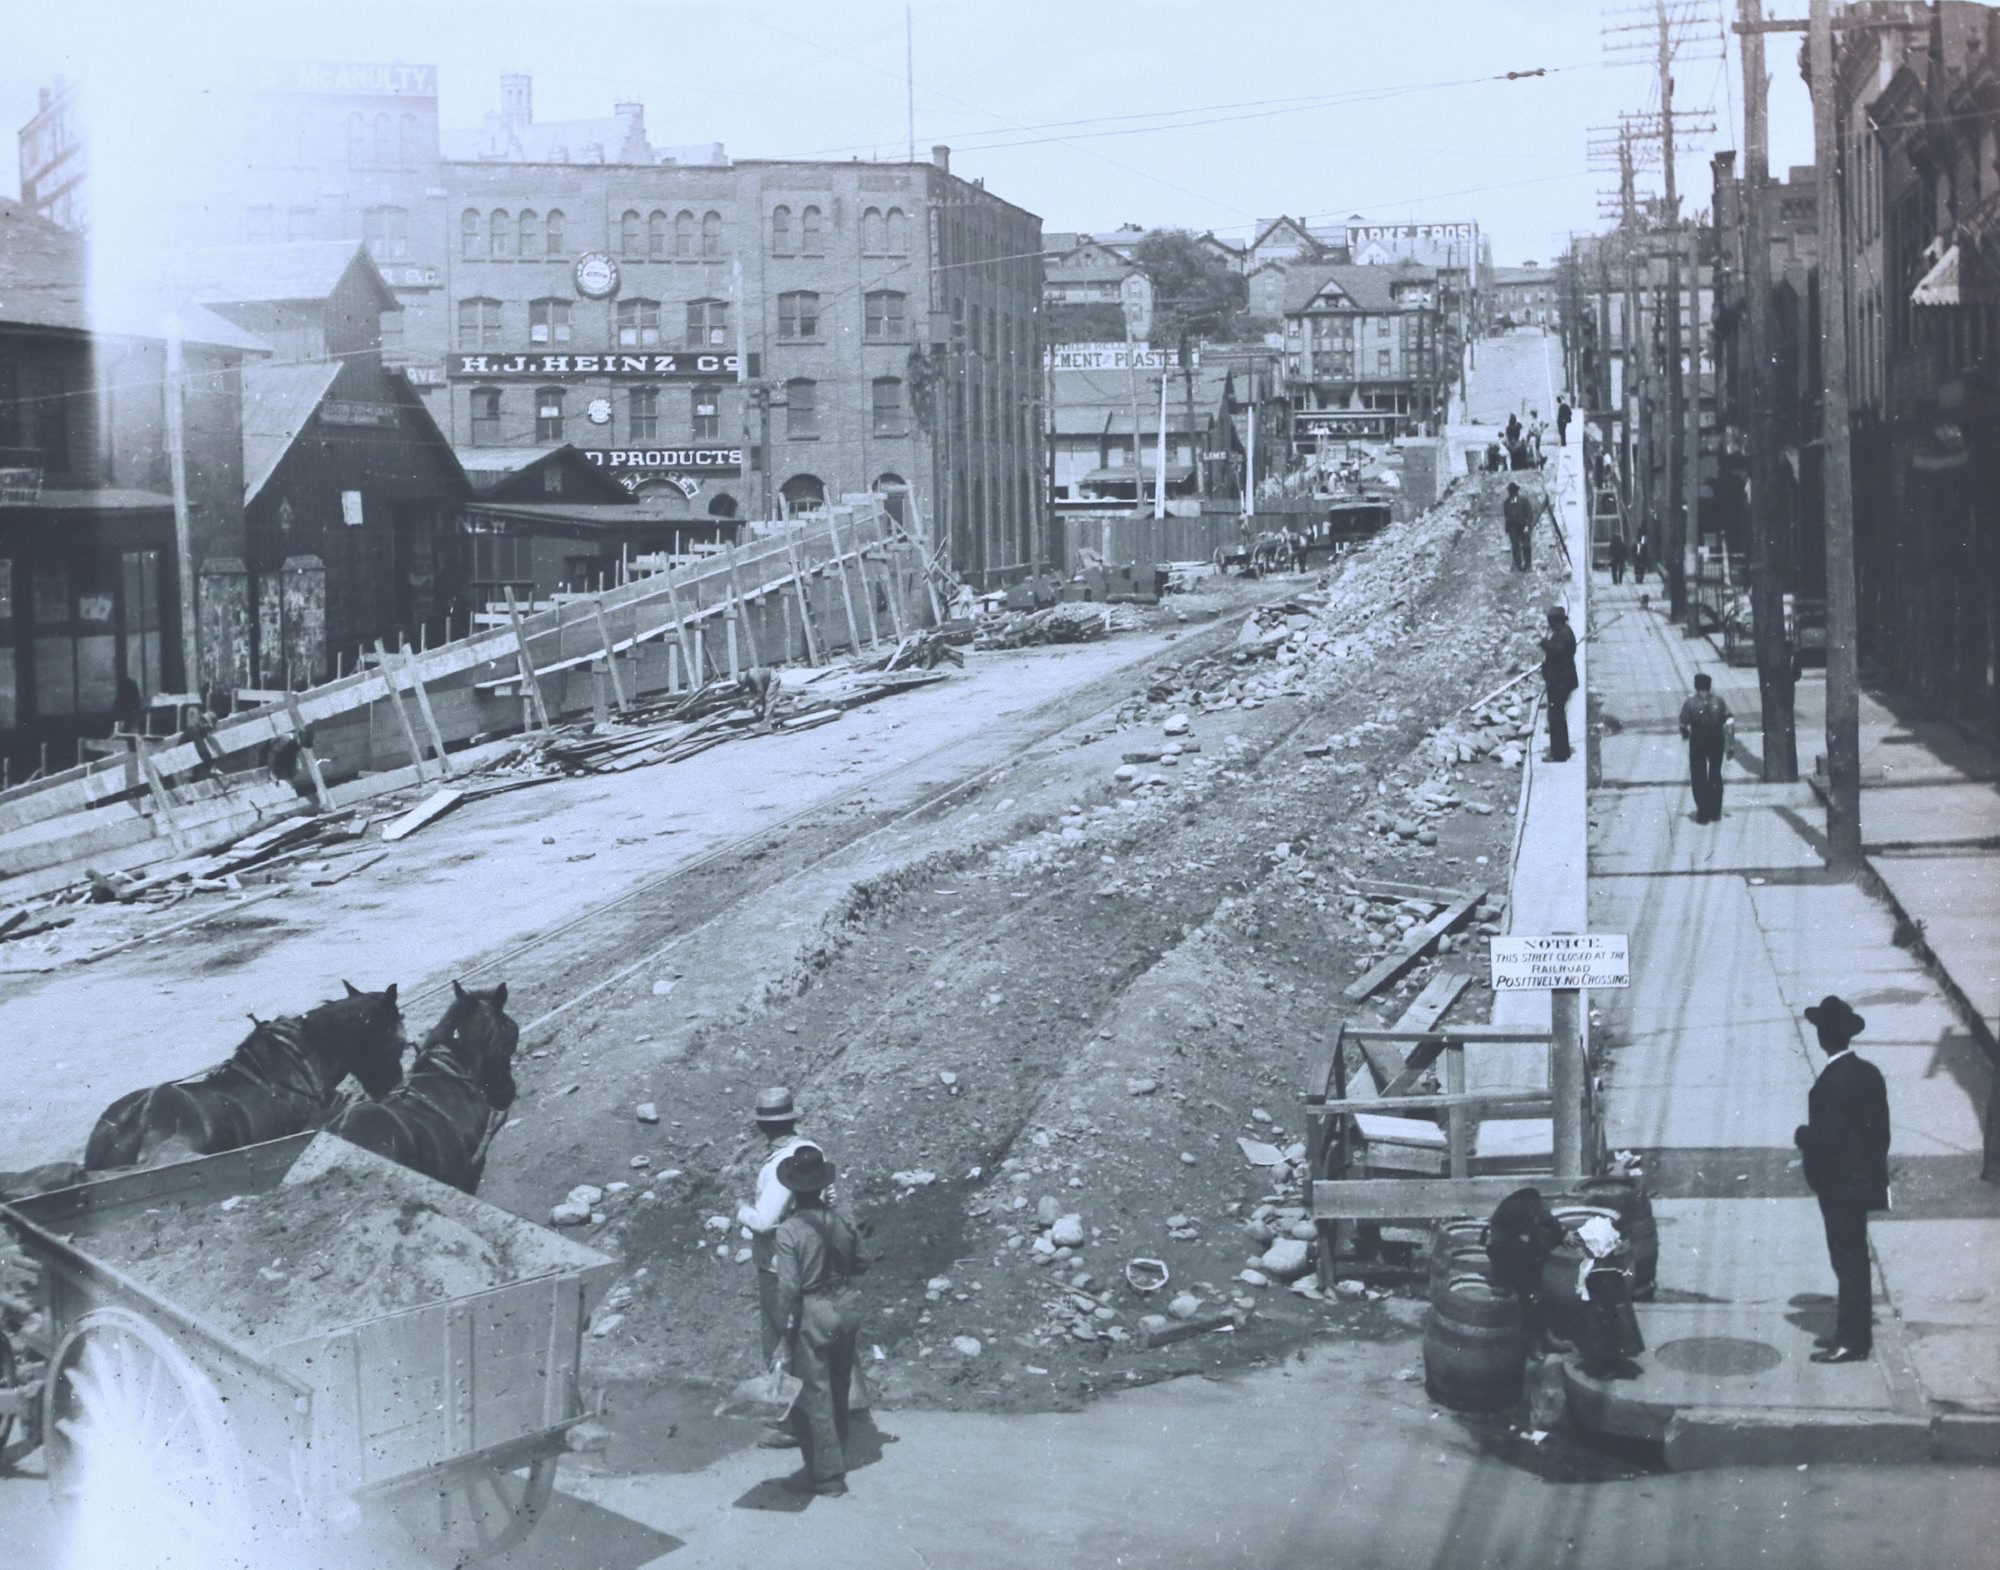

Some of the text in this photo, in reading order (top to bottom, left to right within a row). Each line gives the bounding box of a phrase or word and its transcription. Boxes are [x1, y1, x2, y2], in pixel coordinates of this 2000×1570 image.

[1115, 351, 1184, 367] PLASTE
[610, 450, 742, 466] PRODUCTS
[1496, 950, 1626, 963] THIS STREET CLOSED AT THE
[1531, 964, 1591, 974] RAILROAD
[1495, 975, 1561, 988] POSITIVELY
[1563, 975, 1579, 986] NO
